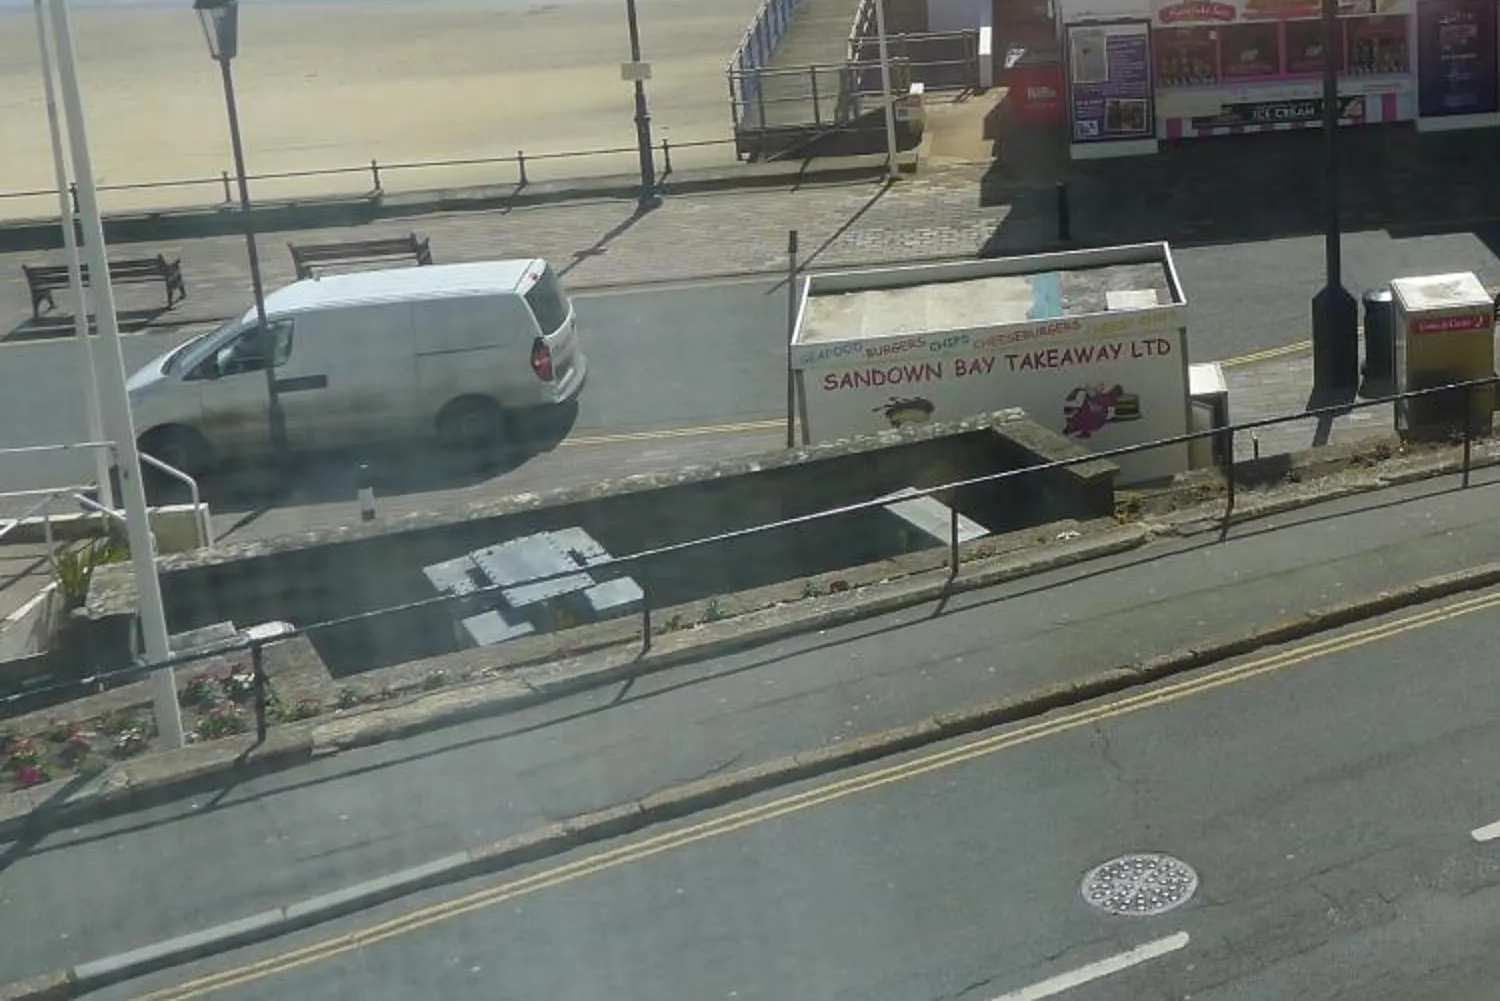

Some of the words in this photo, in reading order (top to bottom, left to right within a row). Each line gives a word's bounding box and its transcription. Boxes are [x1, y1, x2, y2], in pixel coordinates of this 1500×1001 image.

[823, 364, 943, 392] SANDOWN
[954, 356, 996, 378] BAY
[1004, 344, 1123, 373] TAKEAWAY
[1131, 337, 1172, 358] LTD
[866, 336, 927, 359] BURGERS
[929, 333, 971, 353] CHIPS
